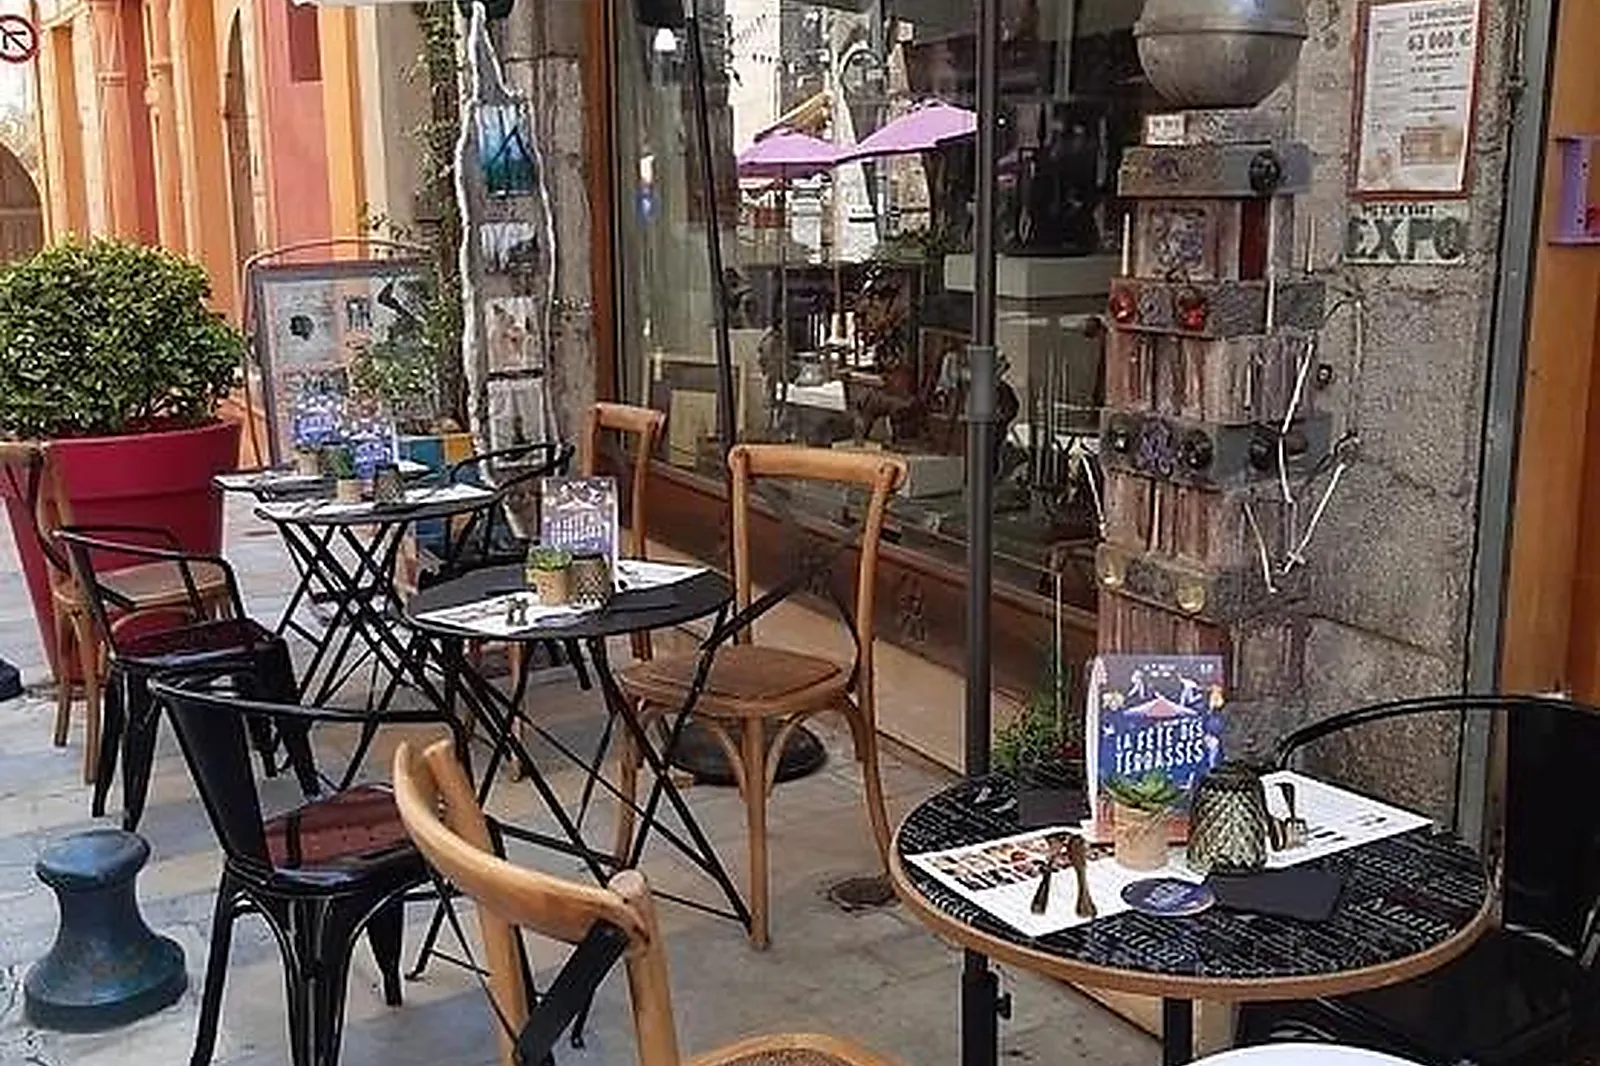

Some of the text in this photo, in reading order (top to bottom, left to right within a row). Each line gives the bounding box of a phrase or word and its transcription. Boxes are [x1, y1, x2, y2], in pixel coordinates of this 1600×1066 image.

[1115, 732, 1133, 751] LA
[1180, 719, 1203, 741] DES
[1115, 739, 1205, 775] TERRASSES
